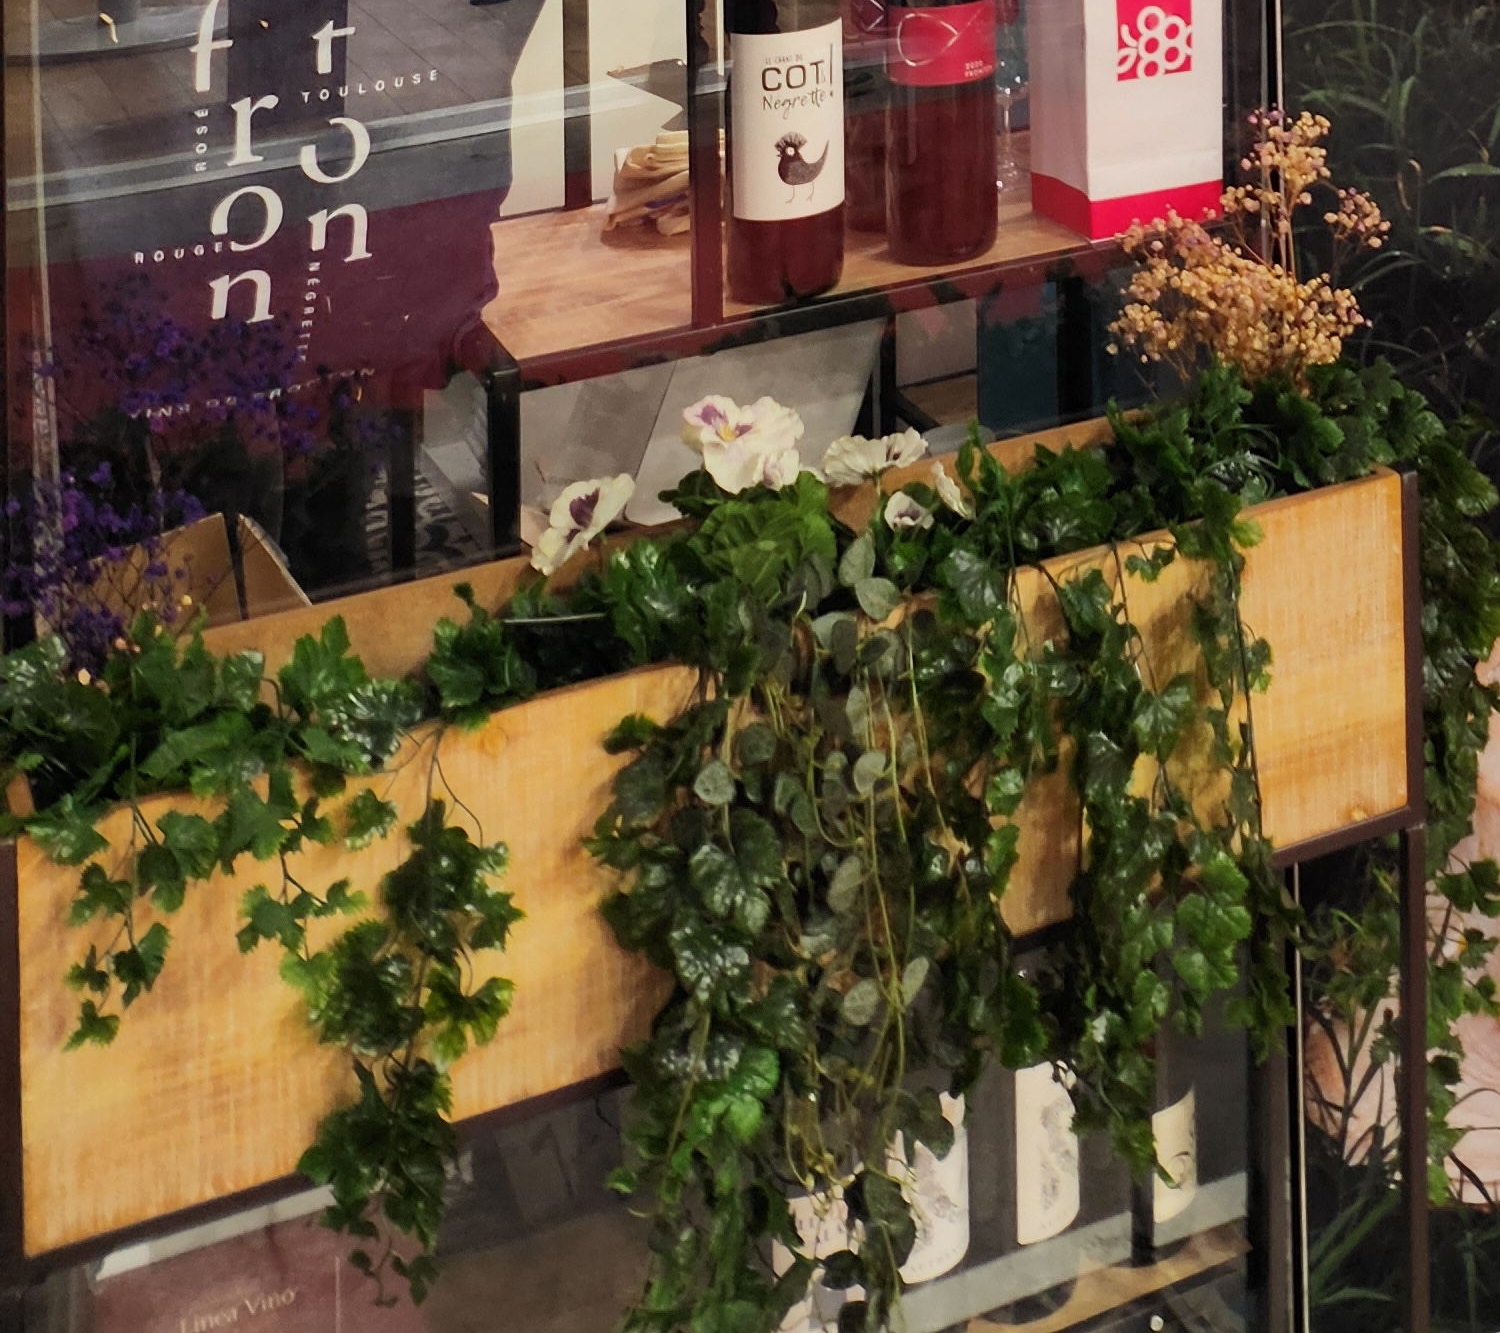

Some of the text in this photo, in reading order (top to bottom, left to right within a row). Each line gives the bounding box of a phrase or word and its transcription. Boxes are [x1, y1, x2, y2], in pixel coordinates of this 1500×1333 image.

[301, 69, 439, 104] TOULOUSE
[761, 59, 825, 92] COT
[193, 108, 209, 172] ROSE
[134, 241, 223, 264] ROUGE
